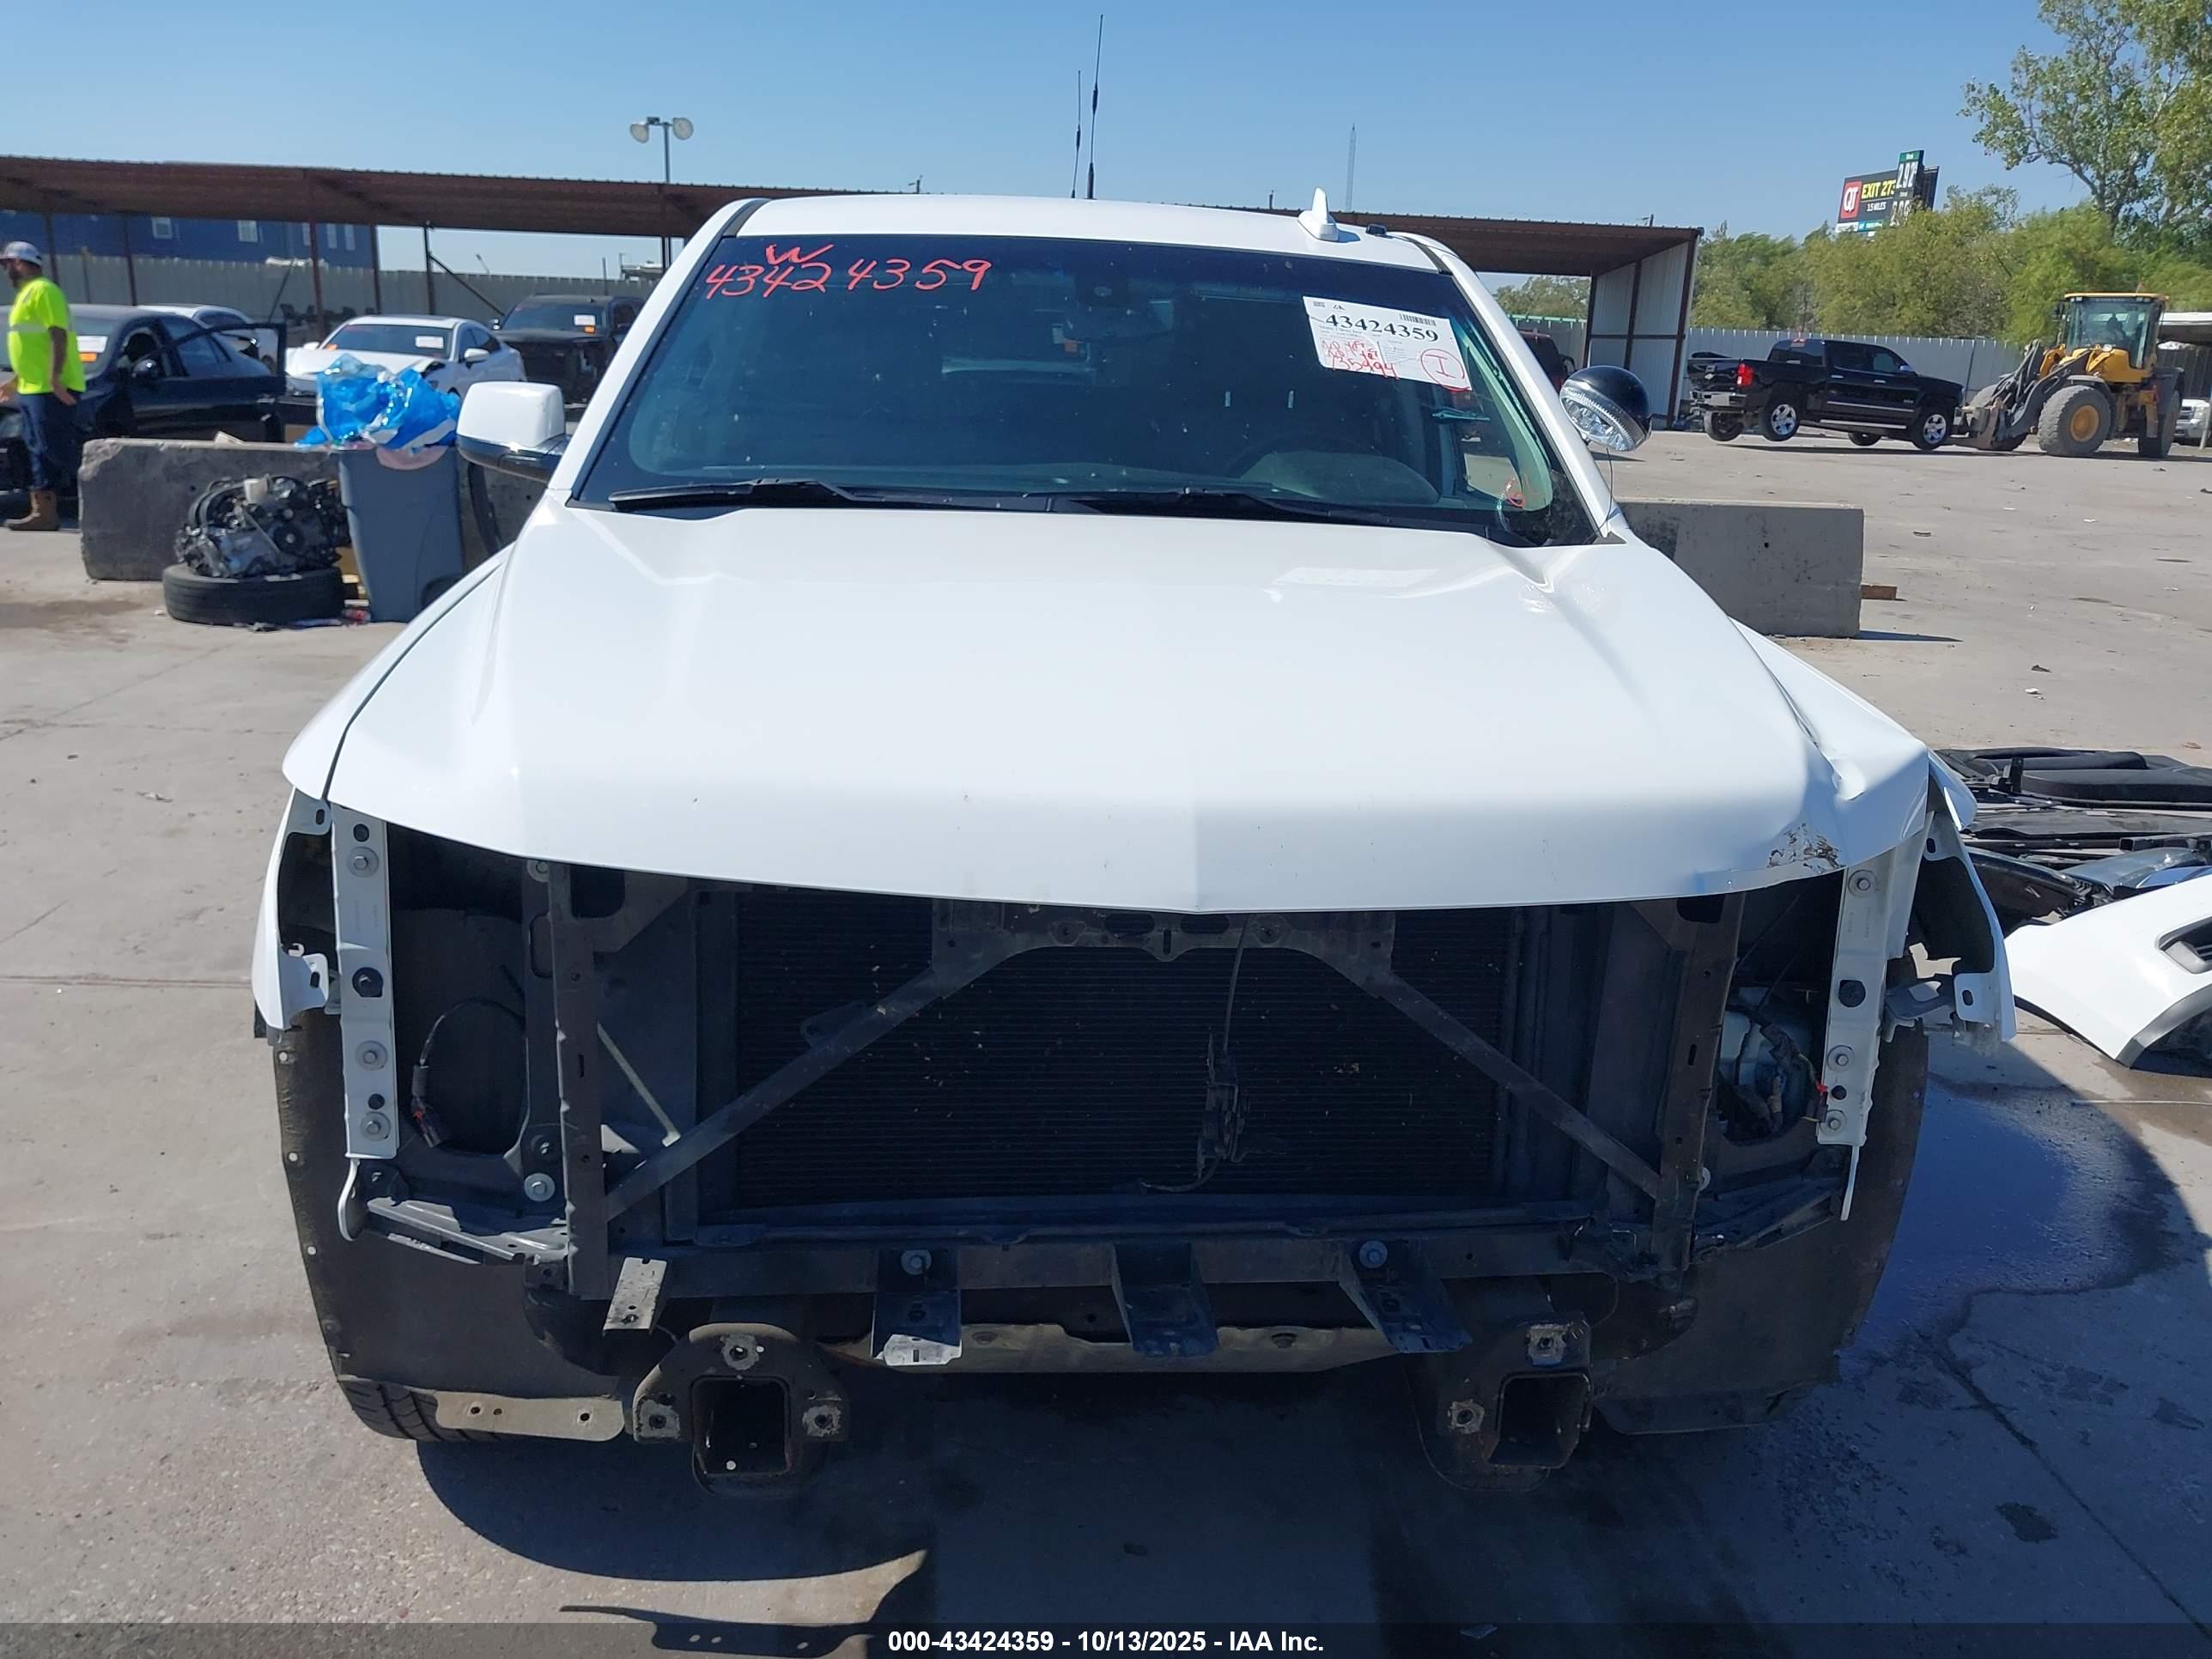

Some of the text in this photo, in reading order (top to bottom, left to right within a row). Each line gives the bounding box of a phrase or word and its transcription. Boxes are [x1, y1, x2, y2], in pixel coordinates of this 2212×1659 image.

[1844, 186, 1859, 214] QT
[1862, 181, 1881, 199] EXIT
[1874, 202, 1887, 210] MILES
[1325, 313, 1439, 343] 43424359
